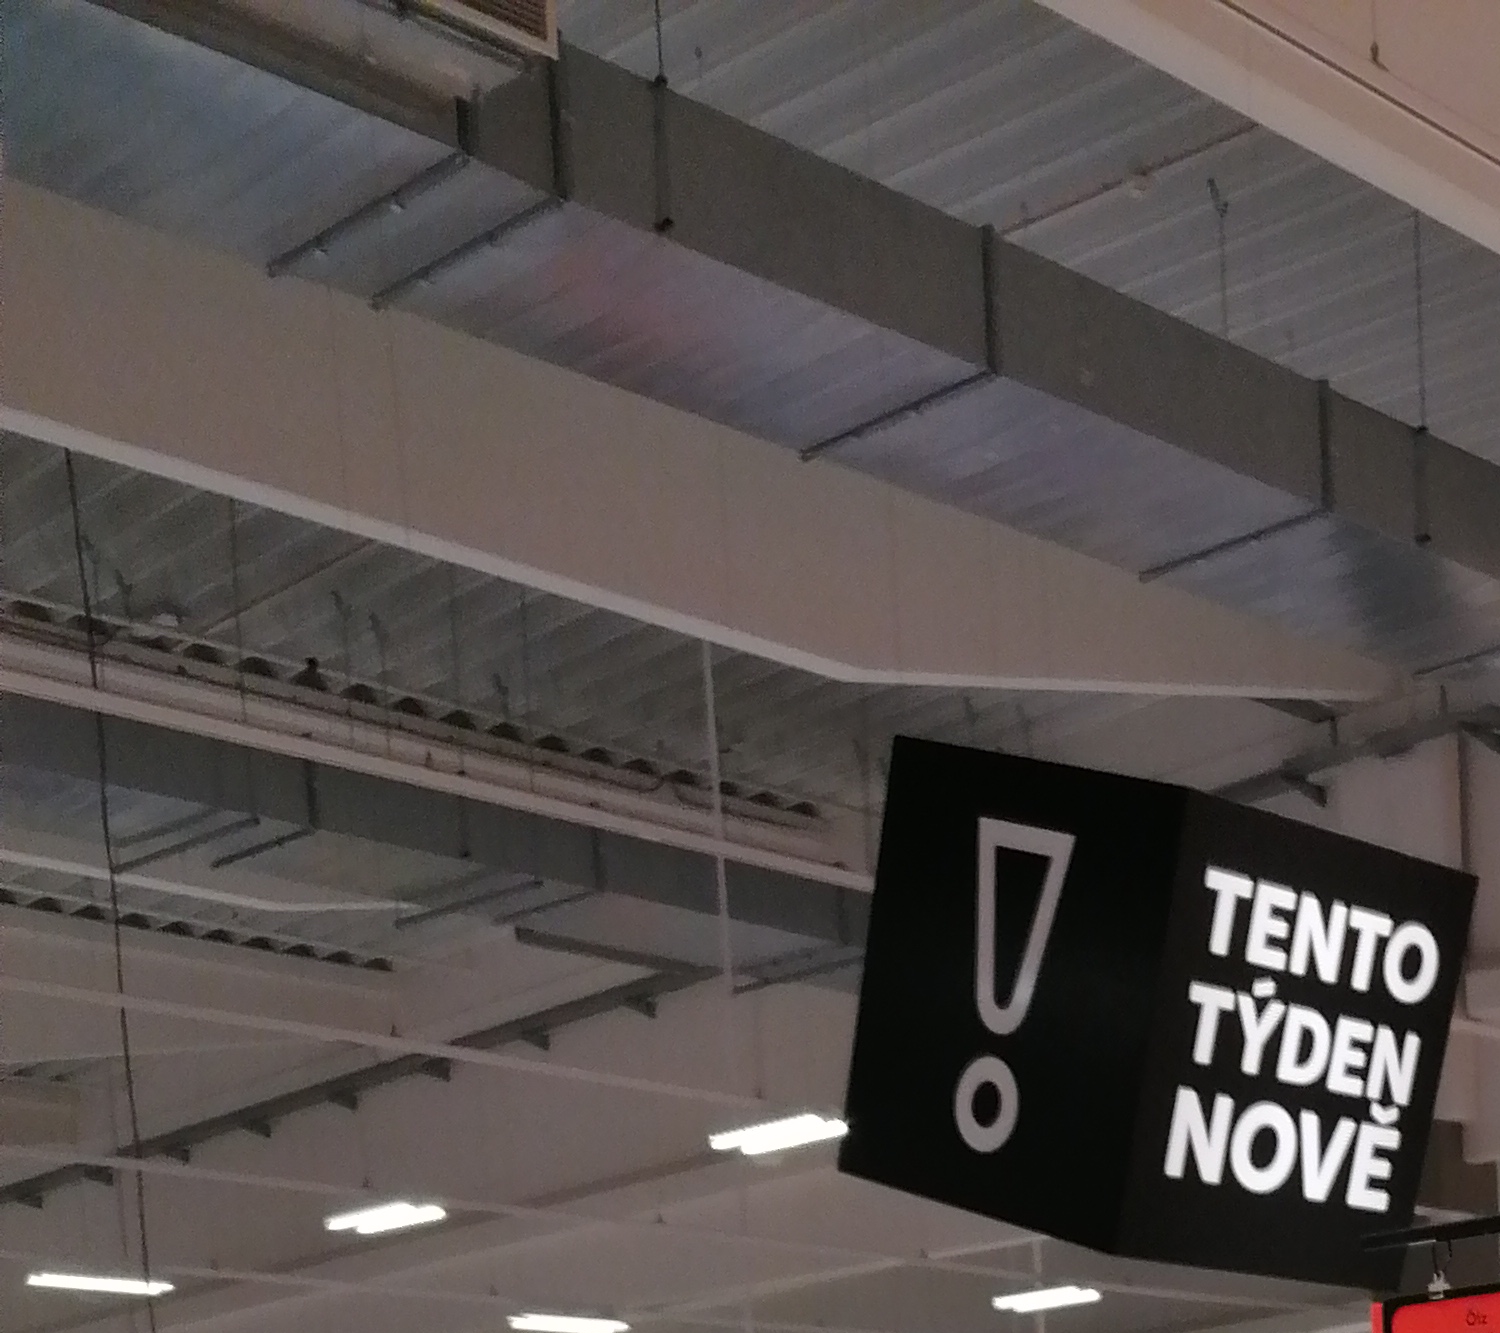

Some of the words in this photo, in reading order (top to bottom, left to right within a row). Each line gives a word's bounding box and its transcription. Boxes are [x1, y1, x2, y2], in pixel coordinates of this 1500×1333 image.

[1203, 865, 1441, 1005] TENTO
[1188, 976, 1422, 1106] TÝDEN
[1163, 1084, 1401, 1213] NOVĚ
